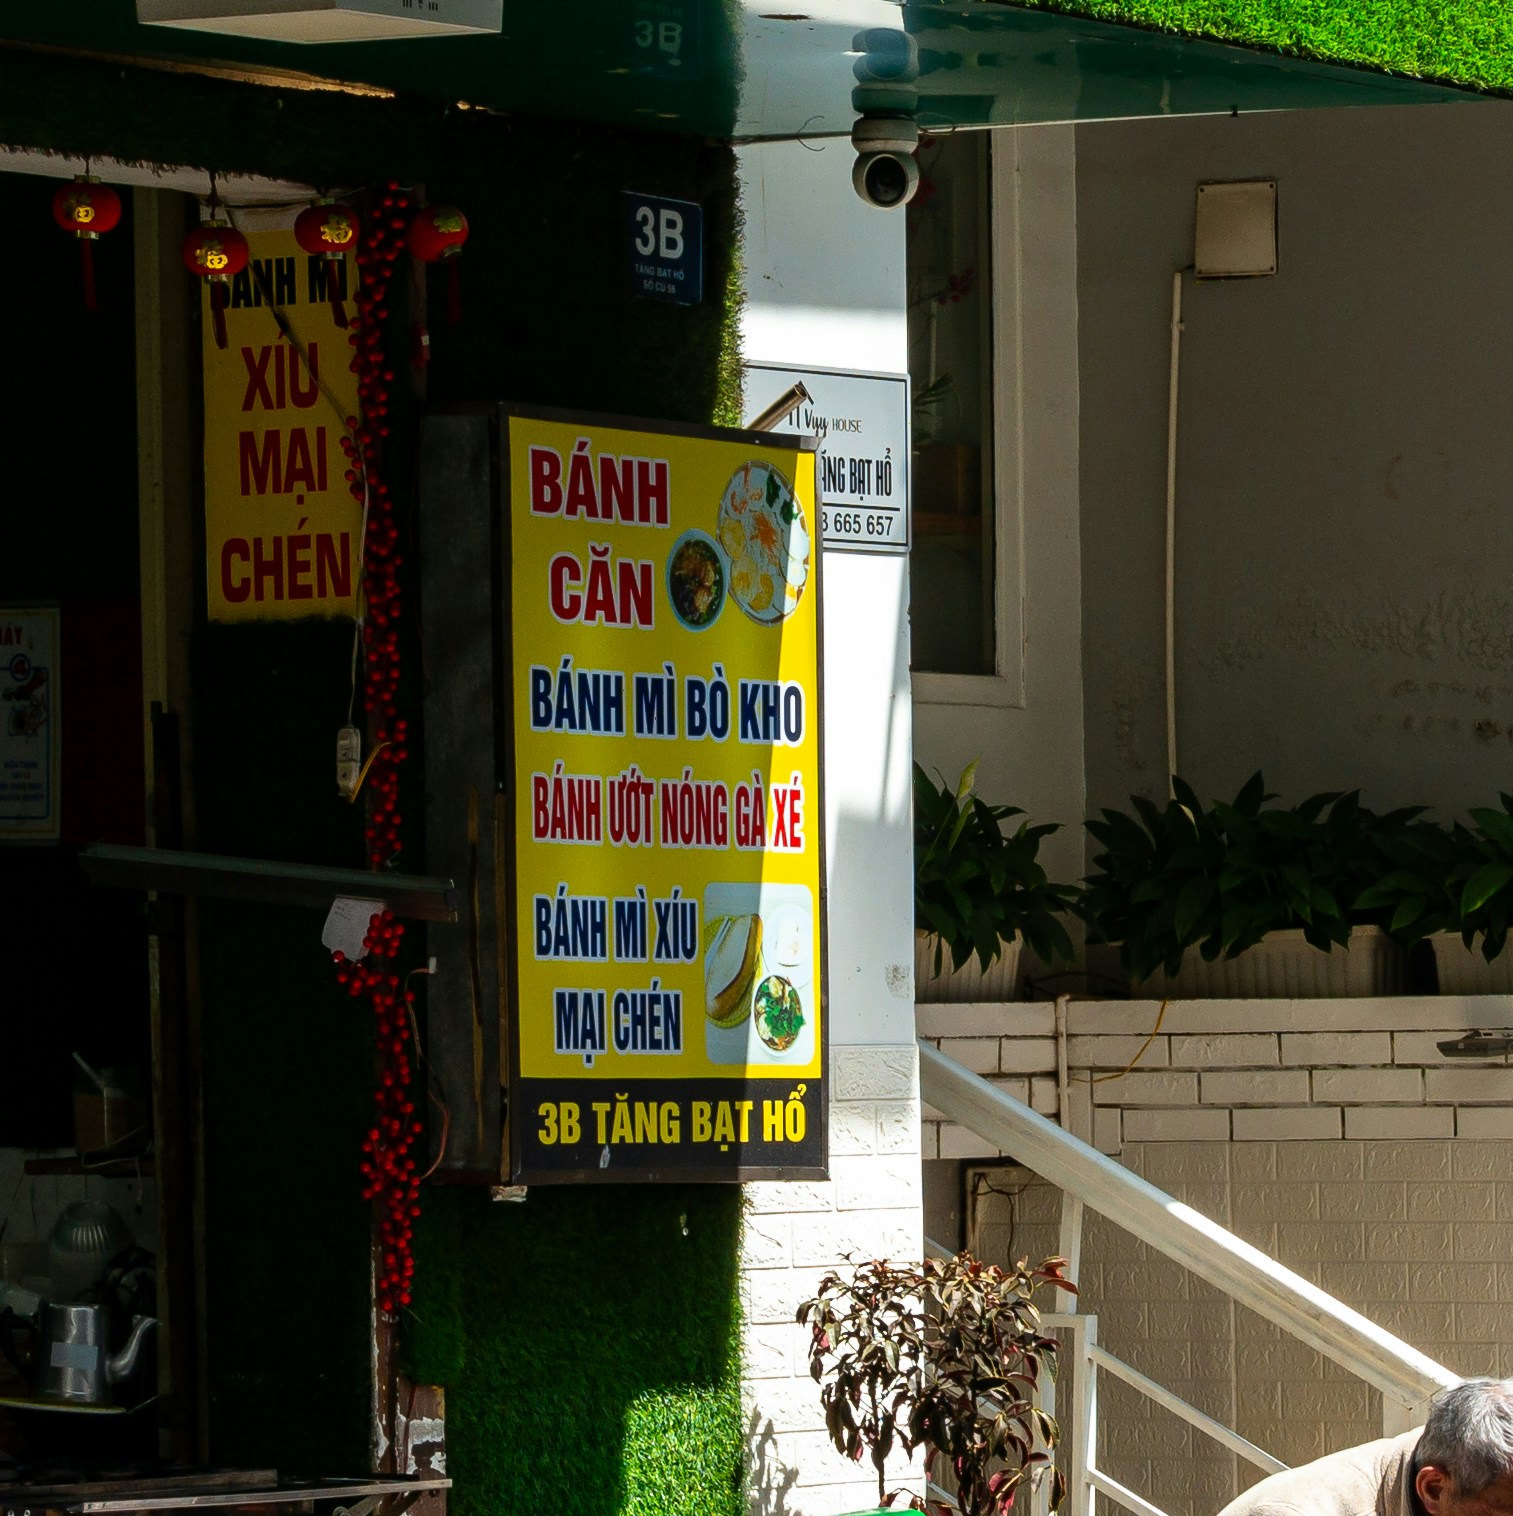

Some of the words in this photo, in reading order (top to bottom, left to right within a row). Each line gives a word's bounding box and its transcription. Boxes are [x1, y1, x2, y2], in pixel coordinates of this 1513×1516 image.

[635, 206, 684, 259] 3B
[241, 328, 318, 411] XÍU
[239, 427, 327, 504] MẠI
[832, 418, 862, 433] HOUSE
[530, 439, 670, 527] BÁNH
[849, 458, 872, 500] BẠT
[876, 447, 892, 496] HỔ
[221, 517, 350, 603] CHÉN
[834, 513, 861, 534] 665
[866, 514, 893, 536] 657
[549, 544, 654, 629] CĂN
[531, 657, 624, 734] BÁNH
[634, 663, 678, 738] MÌ
[687, 664, 729, 740] BÒ
[739, 683, 803, 744] KHO
[532, 763, 601, 842] BÁNH
[608, 767, 655, 844] ƯỚT
[661, 769, 728, 847] NÓNG
[735, 773, 767, 848] GÀ
[773, 776, 802, 849] XÉ
[535, 884, 606, 960] BÁNH
[615, 887, 648, 961] MÌ
[654, 889, 698, 963] XÍU
[555, 990, 606, 1065] MẠI
[613, 980, 683, 1053] CHÉN
[538, 1101, 580, 1145] 3B
[592, 1093, 681, 1145] TĂNG
[692, 1100, 754, 1152] BẠT
[763, 1083, 807, 1143] HỔ
